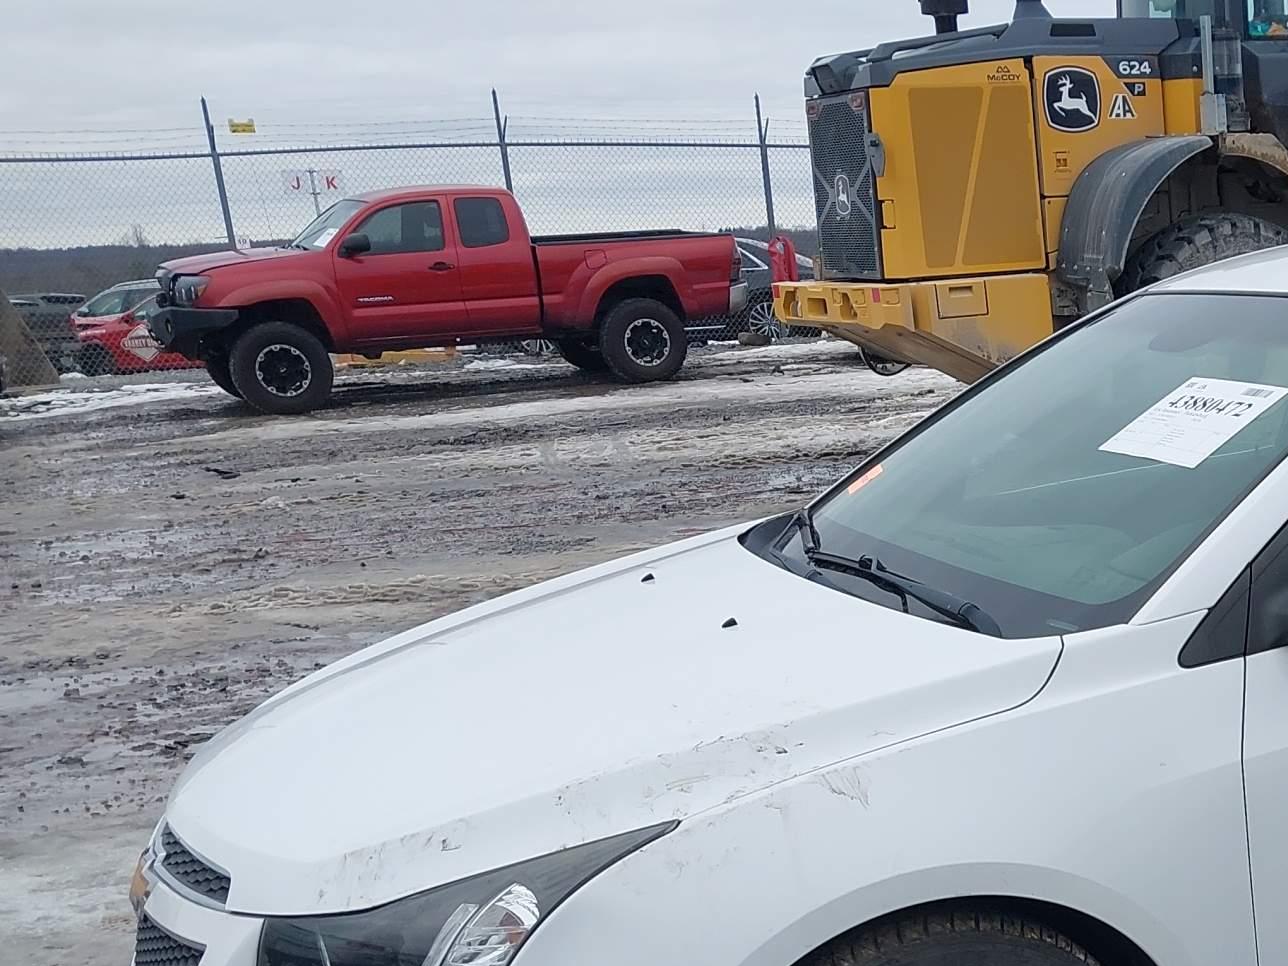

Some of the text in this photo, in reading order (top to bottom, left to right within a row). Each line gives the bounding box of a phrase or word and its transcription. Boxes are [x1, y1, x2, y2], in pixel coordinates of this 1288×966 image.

[1118, 60, 1152, 75] 624
[1134, 84, 1144, 95] P
[291, 176, 301, 190] J
[325, 176, 338, 190] K
[1168, 395, 1254, 417] 43880472
